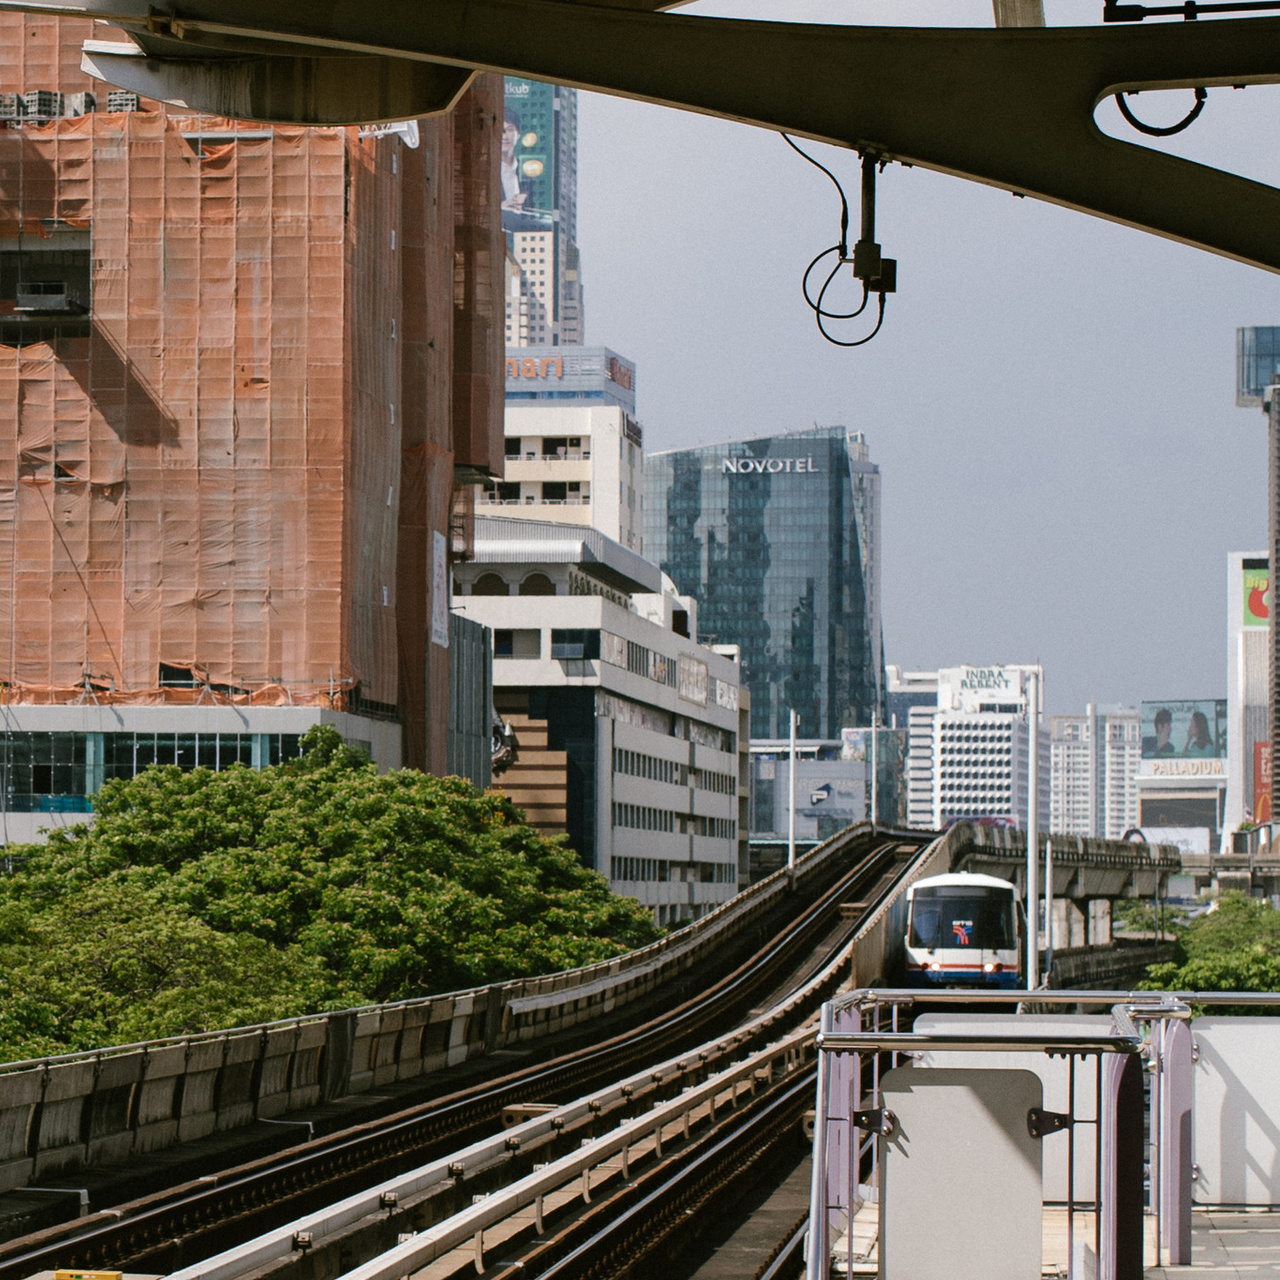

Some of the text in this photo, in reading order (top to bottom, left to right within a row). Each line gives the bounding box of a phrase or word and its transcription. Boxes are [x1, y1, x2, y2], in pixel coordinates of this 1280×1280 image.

[505, 82, 529, 94] tkub
[722, 455, 820, 473] NOVOTEL
[966, 670, 1005, 679] INDRA
[1152, 761, 1223, 775] PALLADIUM
